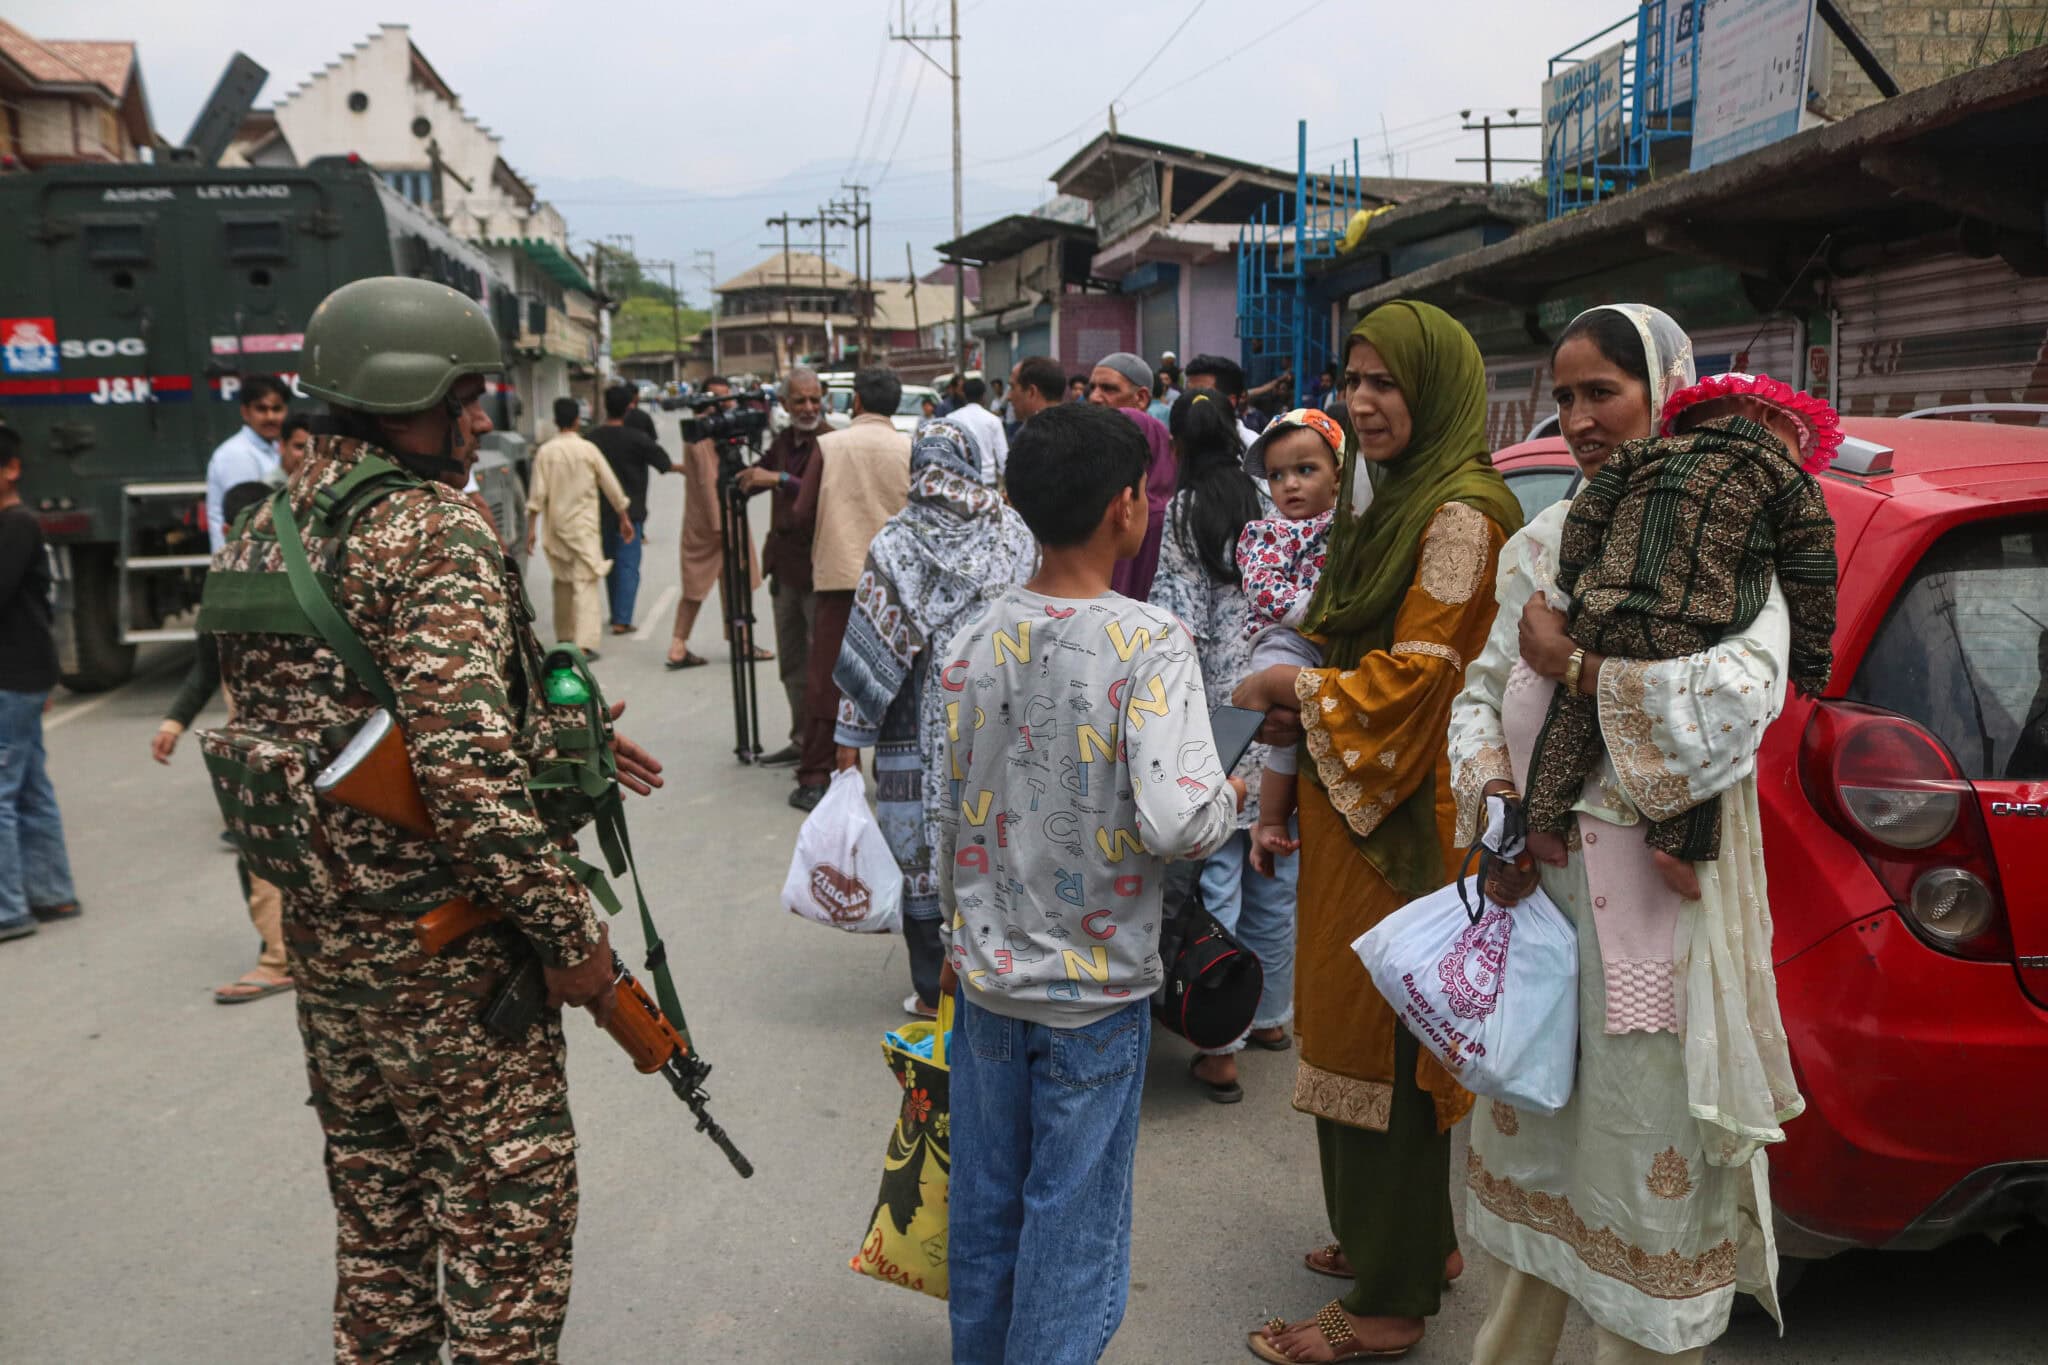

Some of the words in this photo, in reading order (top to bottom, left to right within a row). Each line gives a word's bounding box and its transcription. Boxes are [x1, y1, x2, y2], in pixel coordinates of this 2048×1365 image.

[103, 187, 175, 202] ASHOK
[196, 184, 290, 199] LEYLAND
[60, 338, 147, 358] SOG
[1402, 973, 1435, 1015] BAKERY
[1440, 1020, 1469, 1044] FAST
[863, 1227, 925, 1291] Dress
